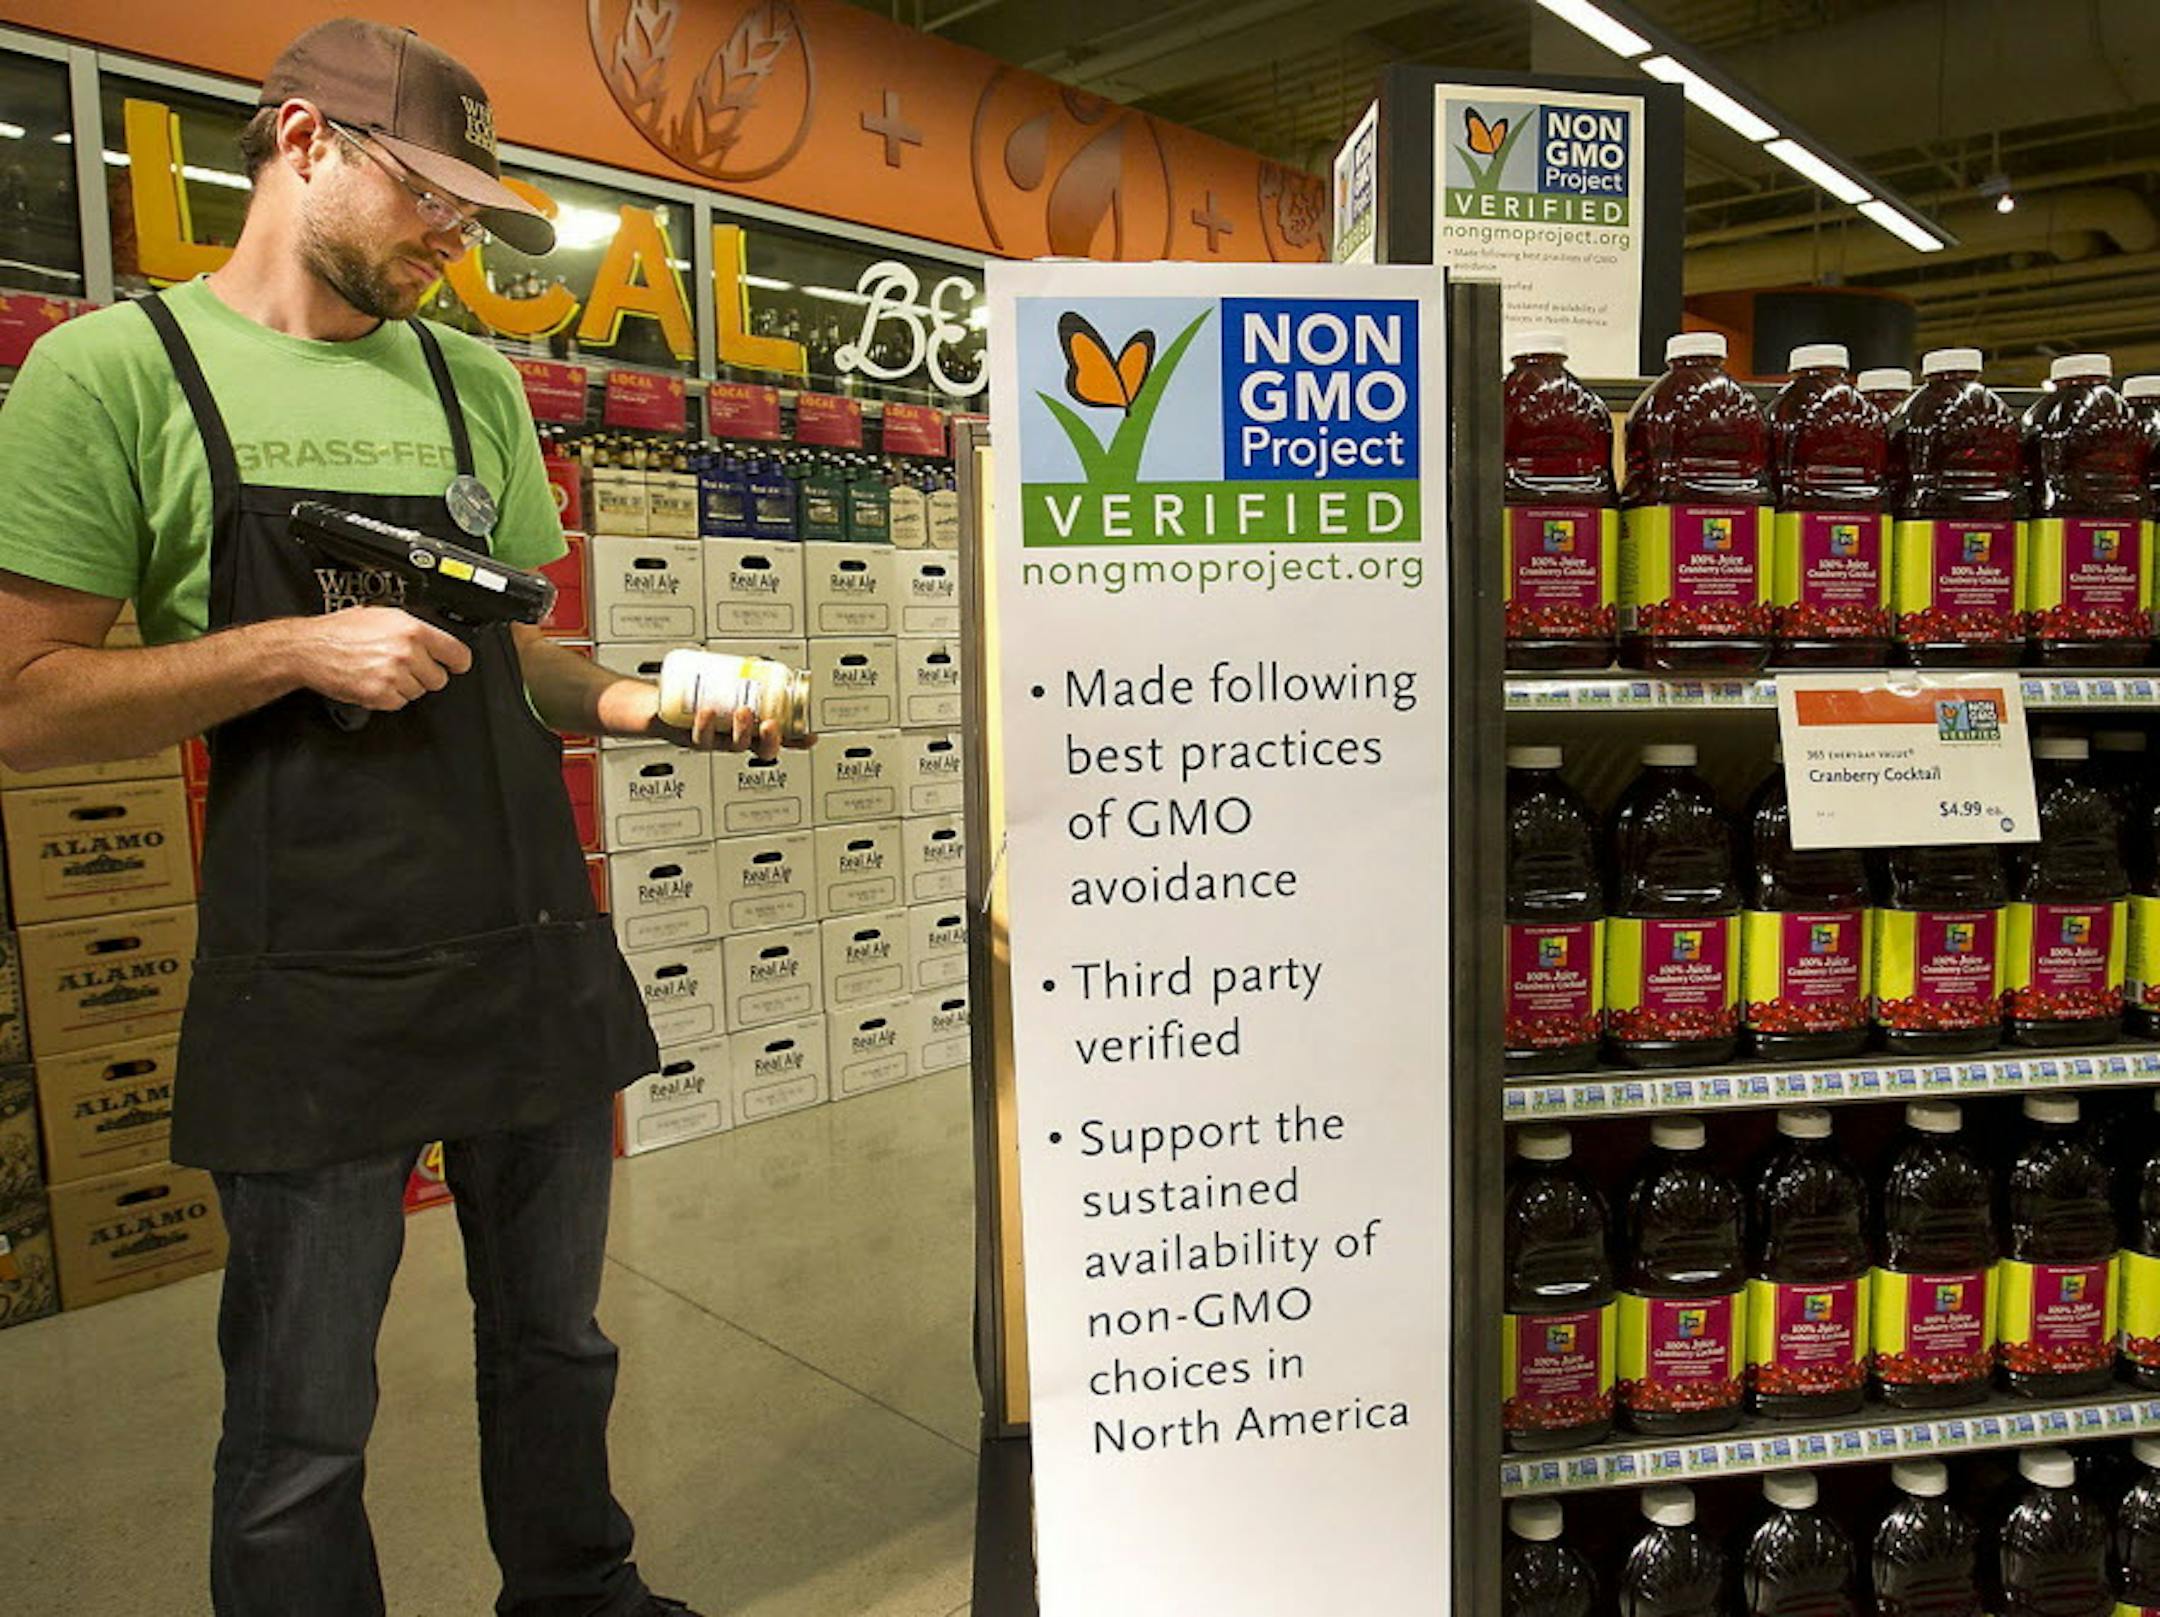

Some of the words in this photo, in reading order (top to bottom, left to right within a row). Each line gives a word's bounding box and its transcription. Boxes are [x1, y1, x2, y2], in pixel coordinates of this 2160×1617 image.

[1548, 112, 1622, 142] NON
[1546, 141, 1624, 170] GMO
[1546, 167, 1623, 194] Project
[1454, 193, 1624, 223] VERIFIED
[124, 98, 808, 377] LCAL
[1443, 224, 1631, 250] nongmoproject.org
[1243, 312, 1402, 366] NON
[609, 373, 653, 387] LOCAL
[710, 385, 751, 399] LOCAL
[800, 396, 835, 410] LOCAL
[1240, 370, 1408, 423] GMO
[885, 406, 919, 419] LOCAL
[1242, 426, 1405, 479] Project
[1044, 491, 1405, 538] VERIFIED
[730, 571, 757, 587] Real
[760, 572, 780, 594] Ale
[1022, 550, 1424, 594] nongmoproject.org
[625, 573, 655, 589] Real
[658, 573, 680, 595] Ale
[830, 574, 855, 589] Real
[859, 575, 876, 594] Ale
[913, 579, 935, 592] Real
[938, 580, 954, 596] Ale
[833, 668, 858, 682] Real
[861, 669, 878, 686] Ale
[917, 668, 941, 681] Real
[943, 668, 959, 685] Ale
[1066, 663, 1194, 707] Made
[1210, 661, 1417, 712] following
[1968, 702, 1995, 711] NON
[1941, 731, 2000, 740] VERIFIED
[919, 756, 942, 771] Real
[944, 755, 960, 773] Ale
[1067, 733, 1164, 775] best
[1181, 730, 1383, 783] practices
[1807, 751, 1825, 760] 365
[738, 770, 765, 786] Real
[768, 769, 788, 789] Ale
[837, 761, 863, 775] Real
[864, 760, 882, 778] Ale
[1809, 768, 1880, 785] Cranberry
[1884, 767, 1942, 781] Cocktail
[629, 780, 660, 796] Real
[663, 779, 686, 799] Ale
[1068, 798, 1118, 840] of
[1127, 797, 1252, 838] GMO
[1940, 801, 1982, 817] $4.99
[40, 831, 164, 859] ALAMO
[924, 843, 946, 858] Real
[839, 854, 864, 868] Real
[866, 851, 884, 869] Ale
[743, 866, 770, 882] Real
[772, 864, 792, 884] Ale
[1071, 861, 1298, 906] avoidance
[639, 882, 668, 899] Real
[672, 879, 694, 899] Ale
[929, 930, 950, 944] Real
[846, 944, 870, 959] Real
[873, 941, 891, 957] Ale
[58, 959, 179, 991] ALAMO
[750, 962, 776, 980] Real
[780, 959, 799, 977] Ale
[1072, 955, 1192, 1000] Third
[1213, 958, 1323, 1006] party
[644, 981, 674, 999] Real
[678, 977, 699, 997] Ale
[932, 1015, 954, 1028] Real
[852, 1034, 877, 1049] Real
[879, 1029, 897, 1046] Ale
[1076, 1017, 1240, 1065] verified
[755, 1055, 782, 1073] Real
[784, 1051, 804, 1069] Ale
[651, 1079, 680, 1097] Real
[683, 1076, 705, 1094] Ale
[75, 1084, 170, 1118] ALAM
[1081, 1115, 1260, 1163] Support
[1276, 1105, 1345, 1144] the
[1083, 1166, 1299, 1218] sustained
[89, 1203, 208, 1246] ALAMO
[1086, 1228, 1319, 1279] availability
[1336, 1219, 1381, 1258] of
[1088, 1286, 1312, 1338] non-GMO
[1090, 1356, 1251, 1396] choices
[1268, 1348, 1302, 1381] in
[1094, 1409, 1219, 1453] North
[1235, 1398, 1409, 1441] America
